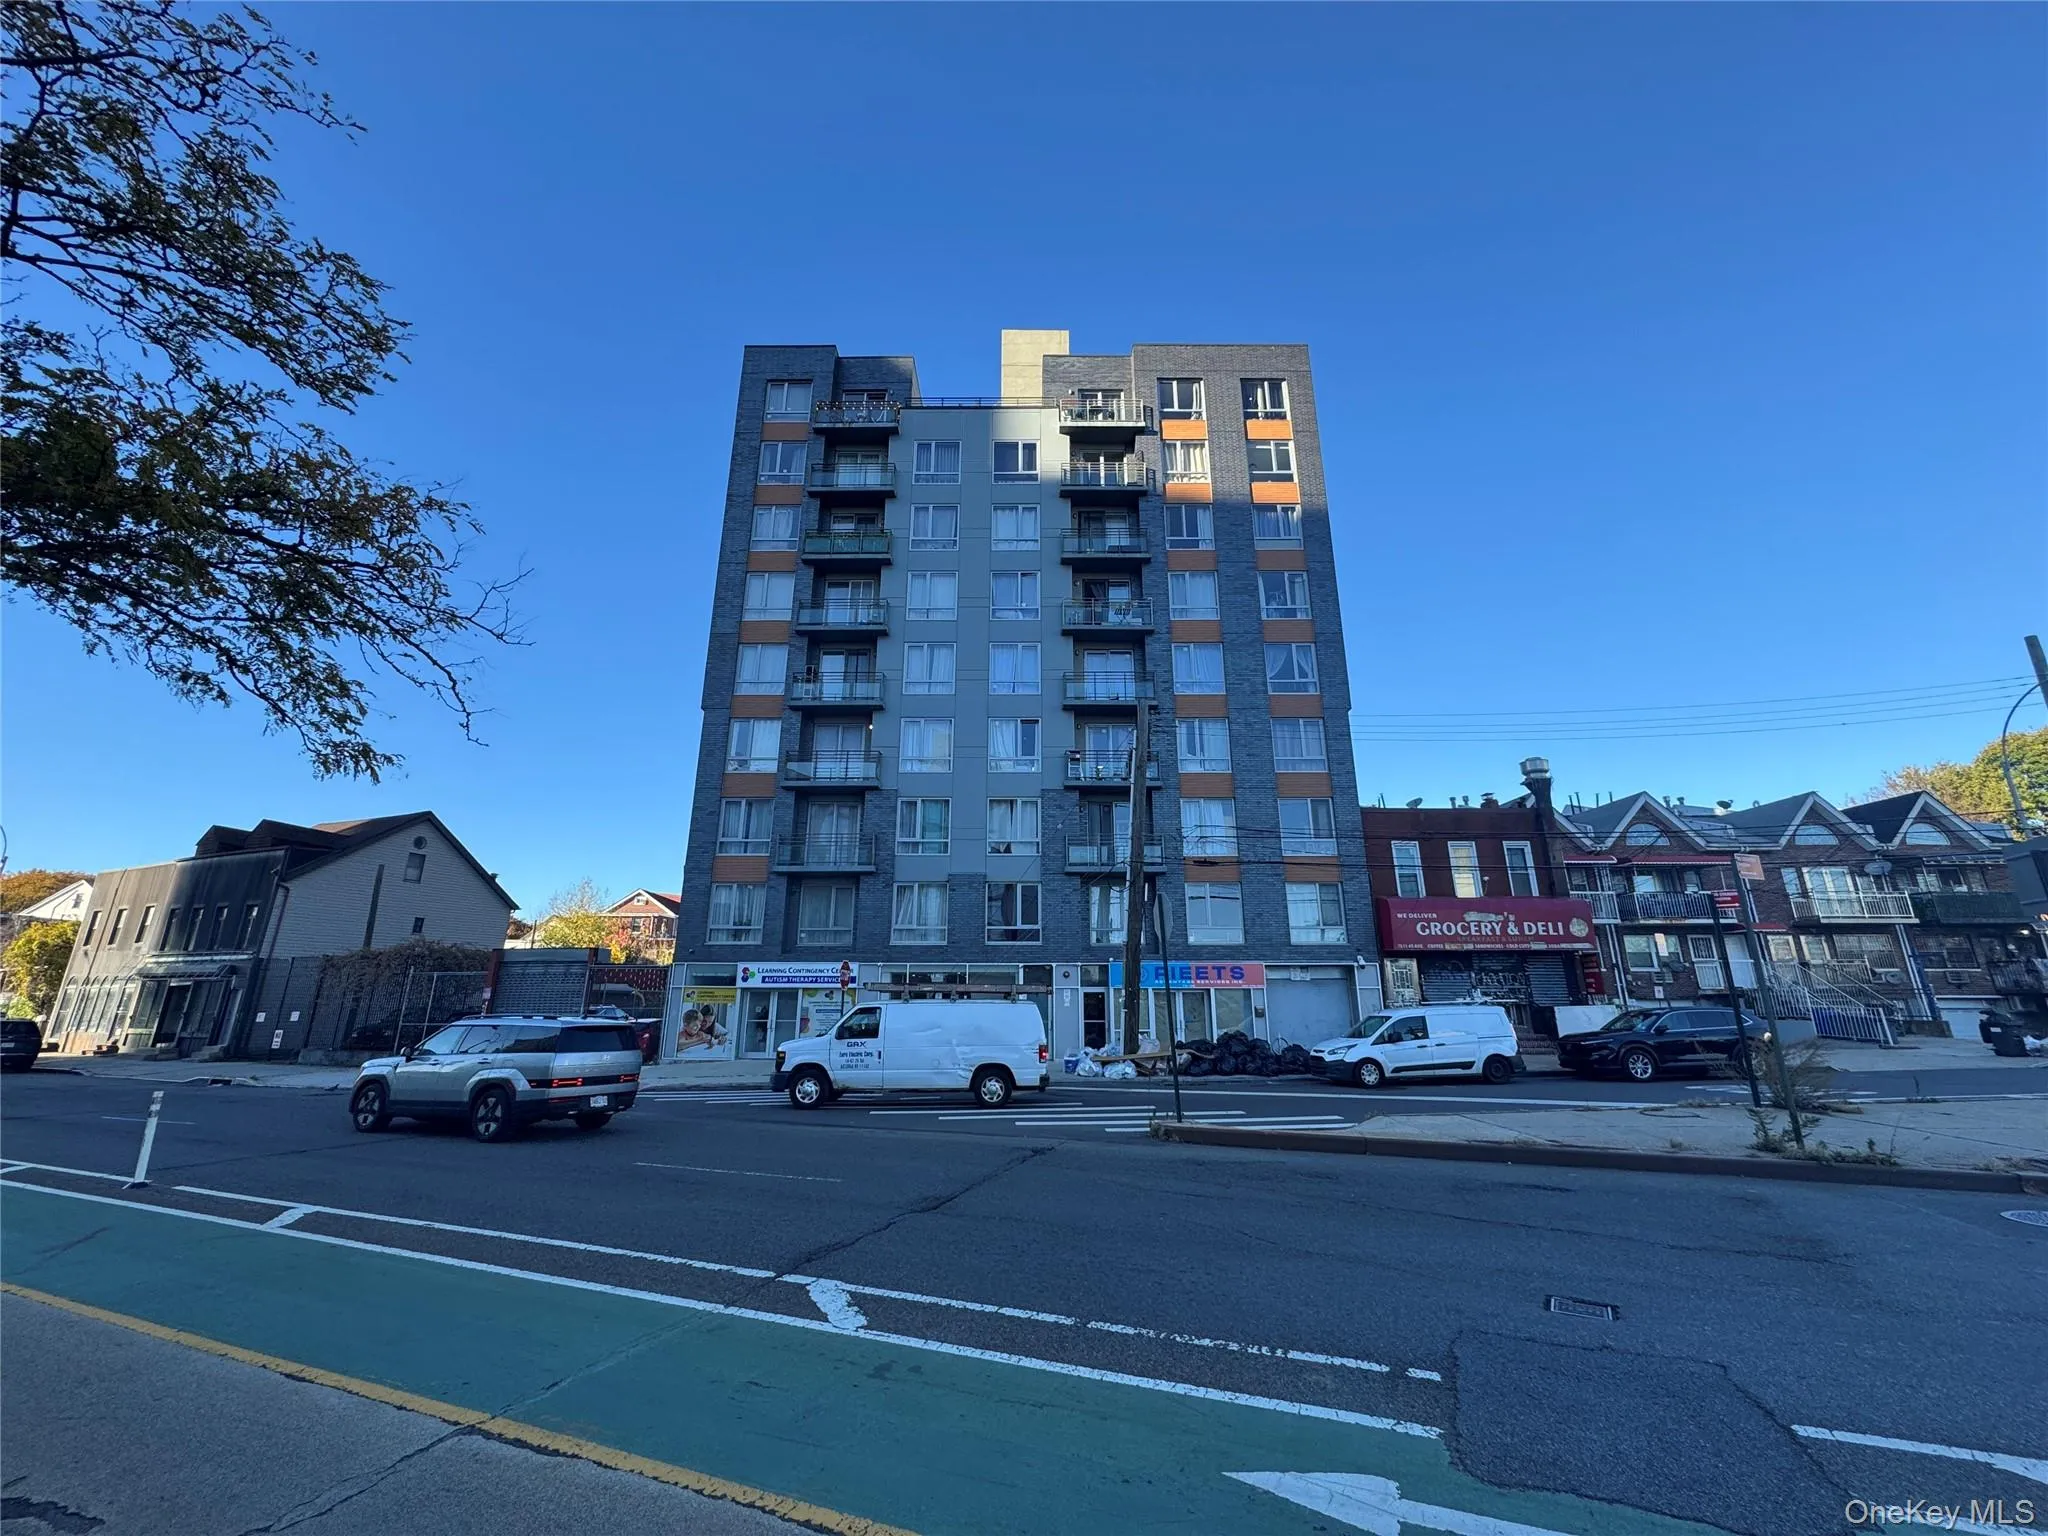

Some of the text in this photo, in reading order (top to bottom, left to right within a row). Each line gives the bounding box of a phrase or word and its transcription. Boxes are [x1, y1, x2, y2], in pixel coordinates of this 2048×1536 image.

[1416, 921, 1564, 936] GROCERY & DELI
[757, 967, 787, 975] LEARNING
[788, 967, 830, 975] CONTINGENCY
[764, 976, 789, 984] AUTISM
[789, 976, 817, 984] THERAPY
